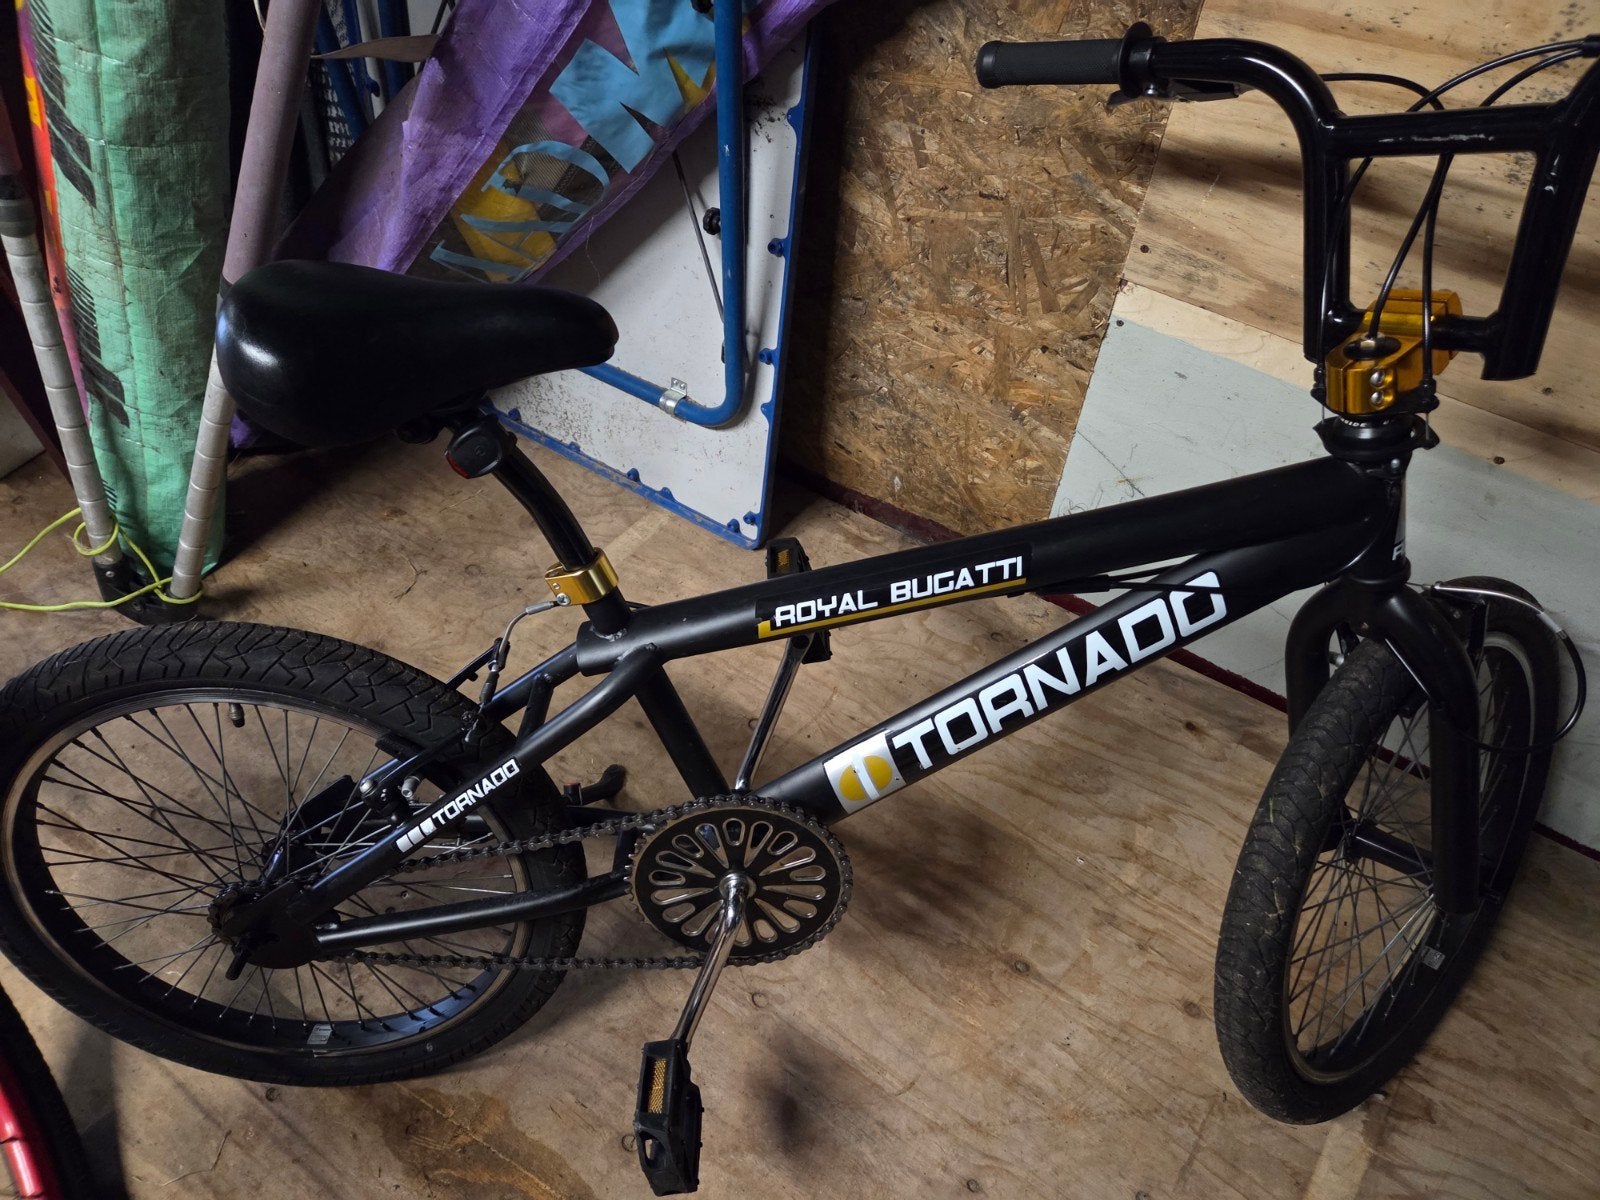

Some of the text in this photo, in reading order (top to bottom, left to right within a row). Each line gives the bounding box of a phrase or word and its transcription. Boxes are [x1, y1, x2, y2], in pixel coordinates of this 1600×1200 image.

[774, 555, 1023, 627] ROYAL BUGATTI
[891, 571, 1227, 769] TORNADO
[431, 758, 520, 825] TORNADO
